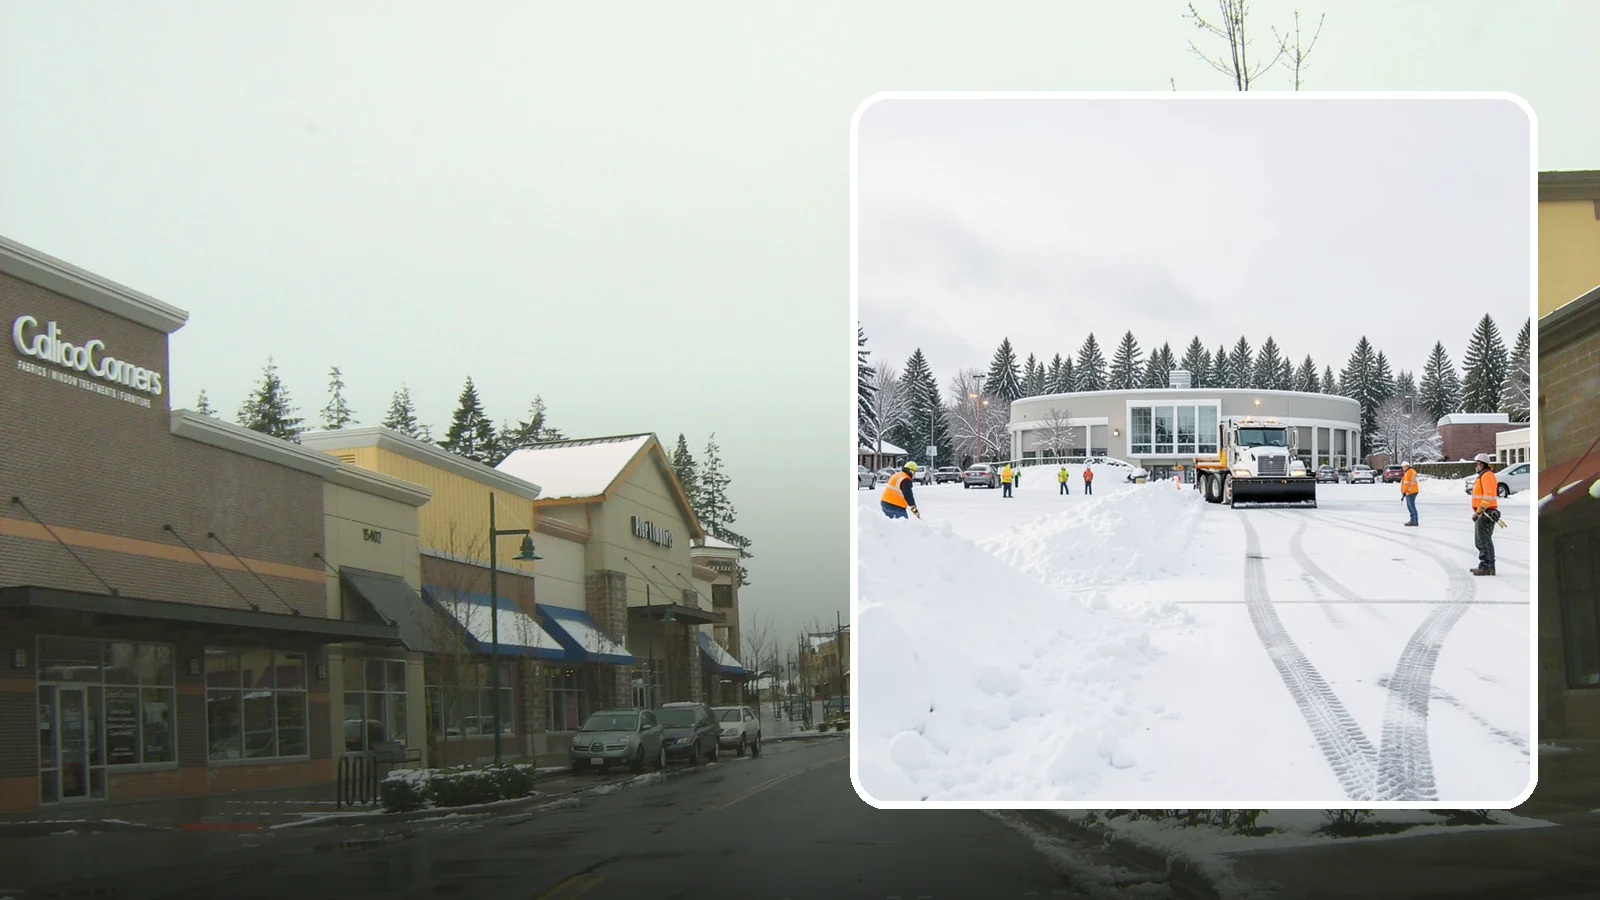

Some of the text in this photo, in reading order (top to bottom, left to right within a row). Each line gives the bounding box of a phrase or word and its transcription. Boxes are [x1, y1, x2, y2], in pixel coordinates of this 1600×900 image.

[17, 360, 47, 377] FABRICS
[51, 371, 78, 387] WINDOW
[79, 378, 117, 399] TREATMENTS
